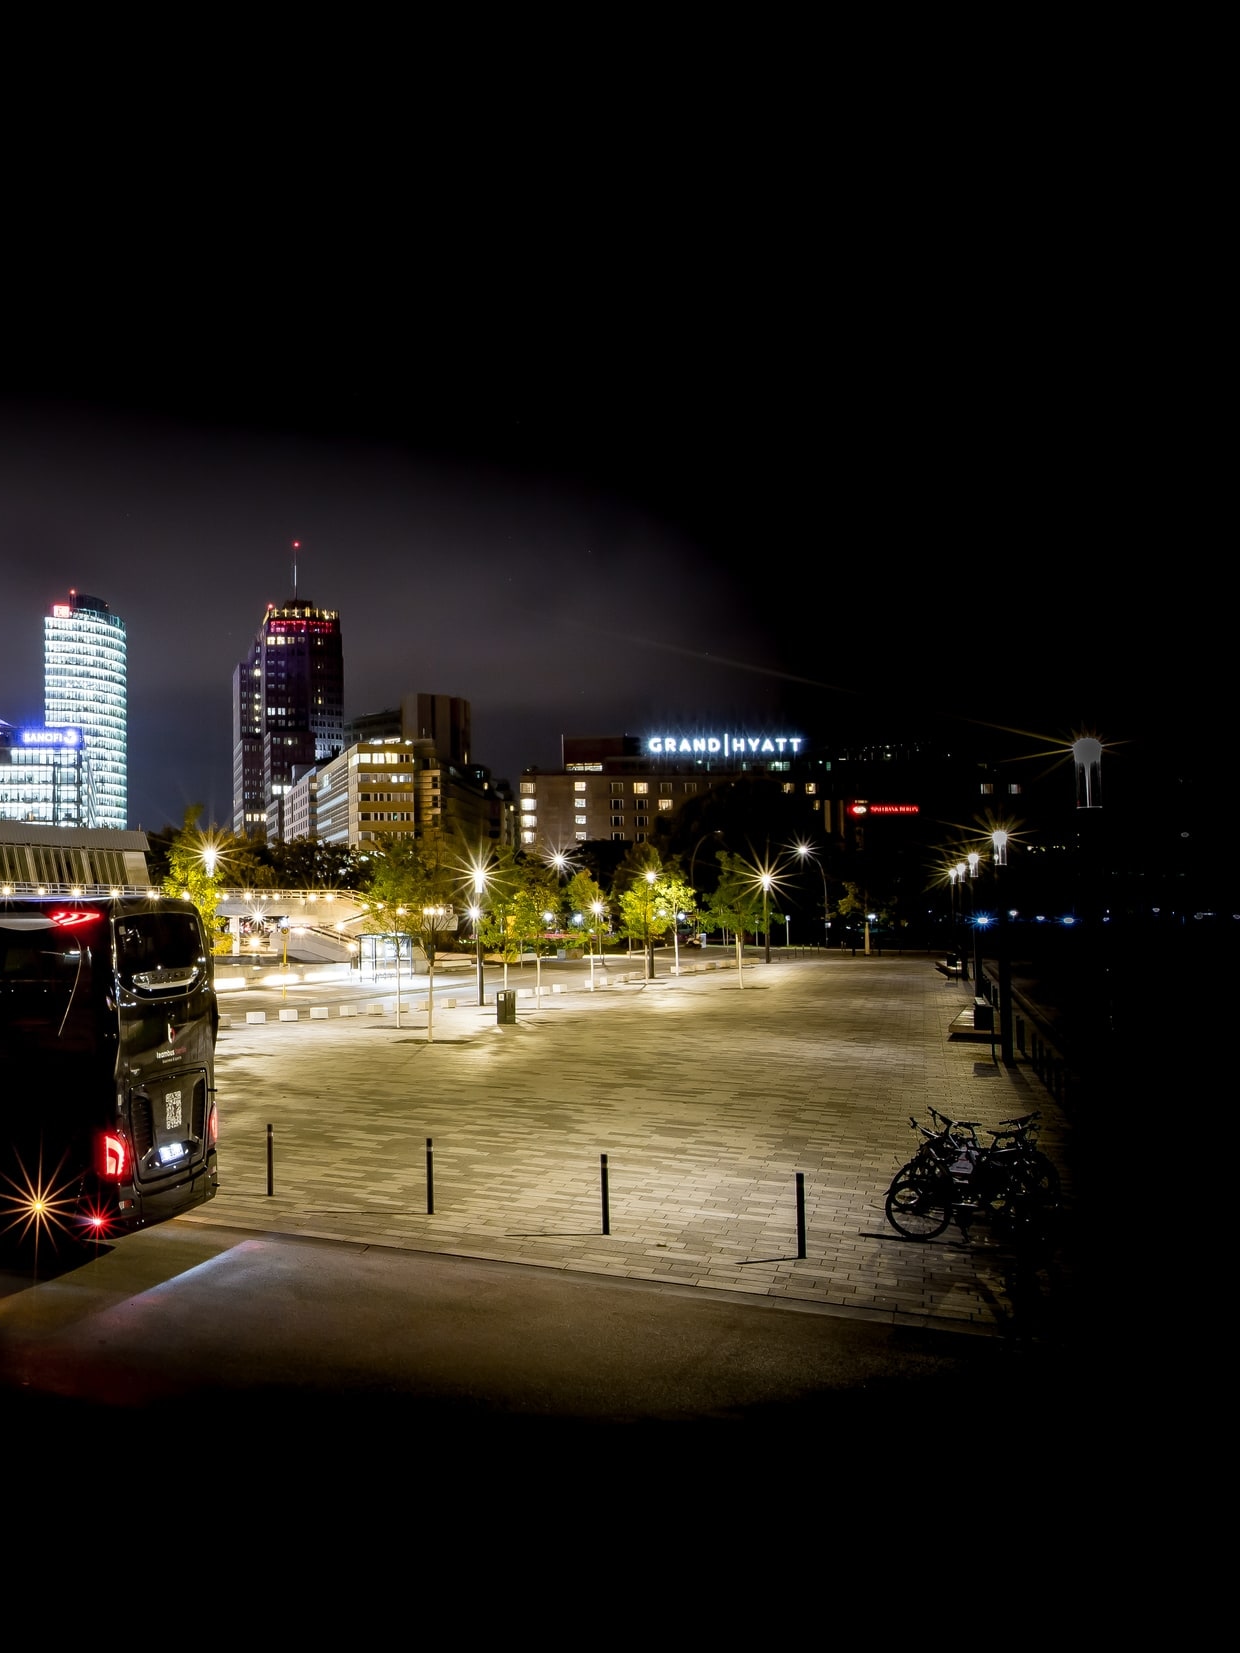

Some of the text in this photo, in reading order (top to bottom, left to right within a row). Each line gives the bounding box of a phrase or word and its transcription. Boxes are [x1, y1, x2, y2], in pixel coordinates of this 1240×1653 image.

[24, 733, 63, 743] SANOFI
[648, 737, 802, 752] GRAND HYATT
